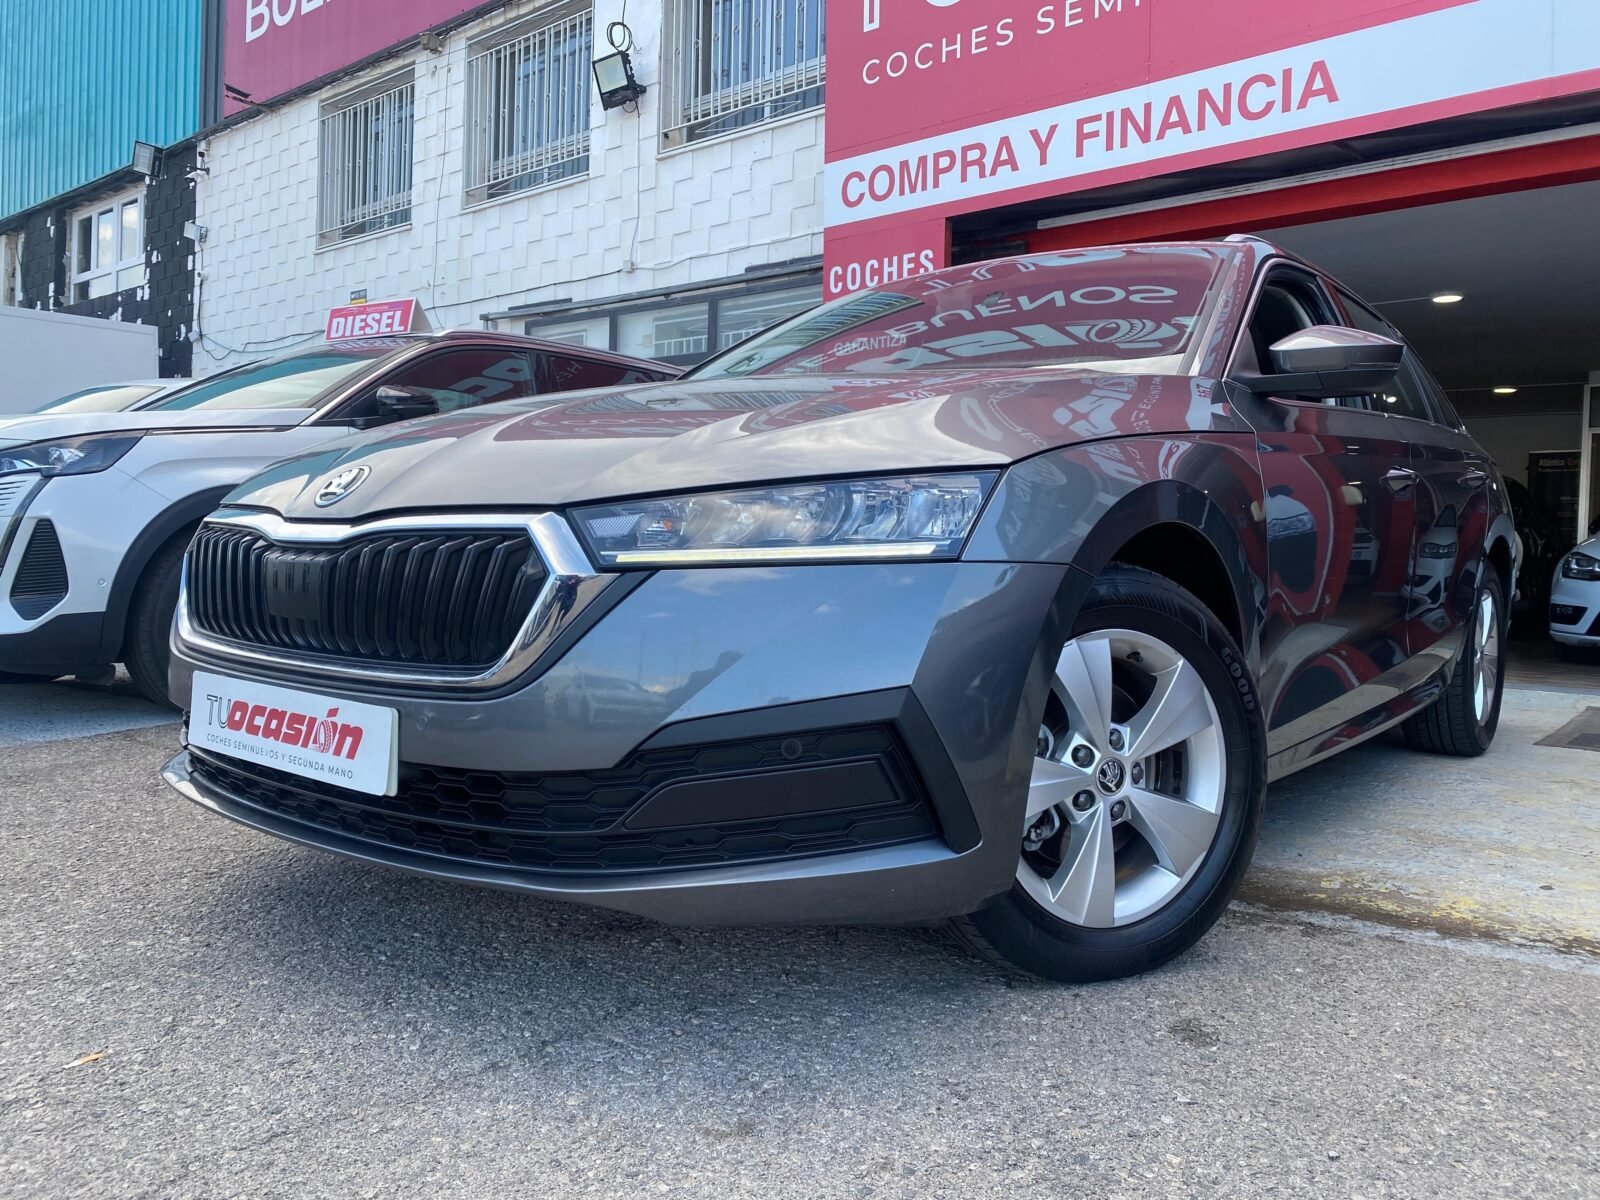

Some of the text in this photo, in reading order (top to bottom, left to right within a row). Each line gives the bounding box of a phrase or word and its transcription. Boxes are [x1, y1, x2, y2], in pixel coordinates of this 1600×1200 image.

[861, 0, 1141, 85] COCHES SEM
[841, 59, 1340, 209] COMPRA Y FINANCIA
[829, 249, 934, 294] COCHES
[330, 310, 405, 338] DIESEL
[206, 733, 354, 780] COCHES SEMINUEVOS Y SEGUNDA MANO
